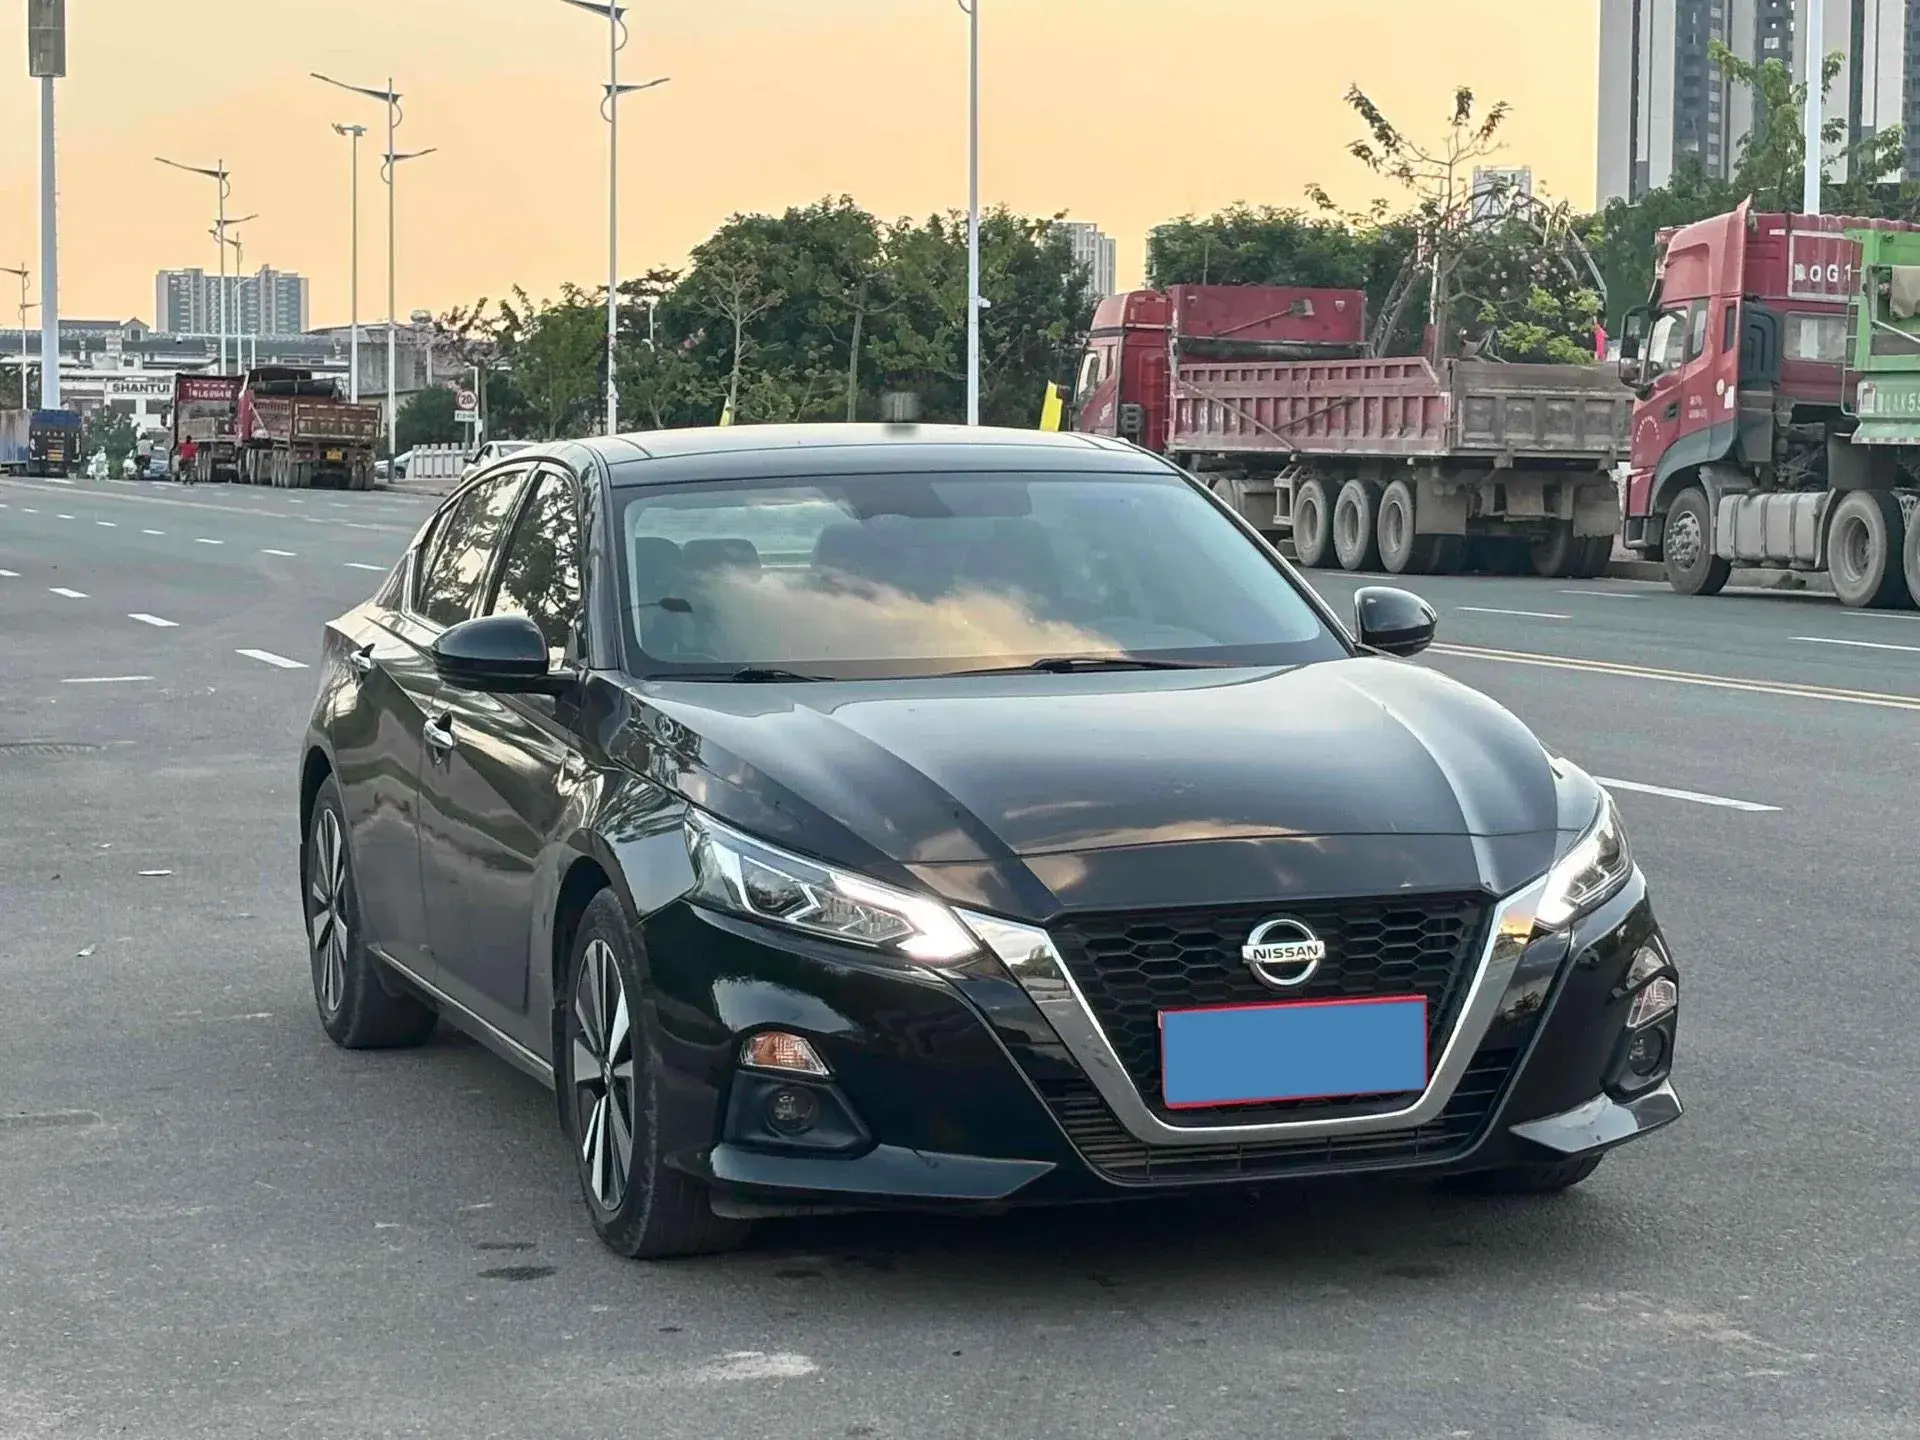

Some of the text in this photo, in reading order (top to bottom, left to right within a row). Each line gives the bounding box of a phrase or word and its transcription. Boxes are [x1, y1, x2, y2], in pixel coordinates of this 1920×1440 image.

[112, 383, 170, 393] SHANTUI
[461, 394, 472, 404] 20
[1253, 945, 1318, 959] NISSAN
